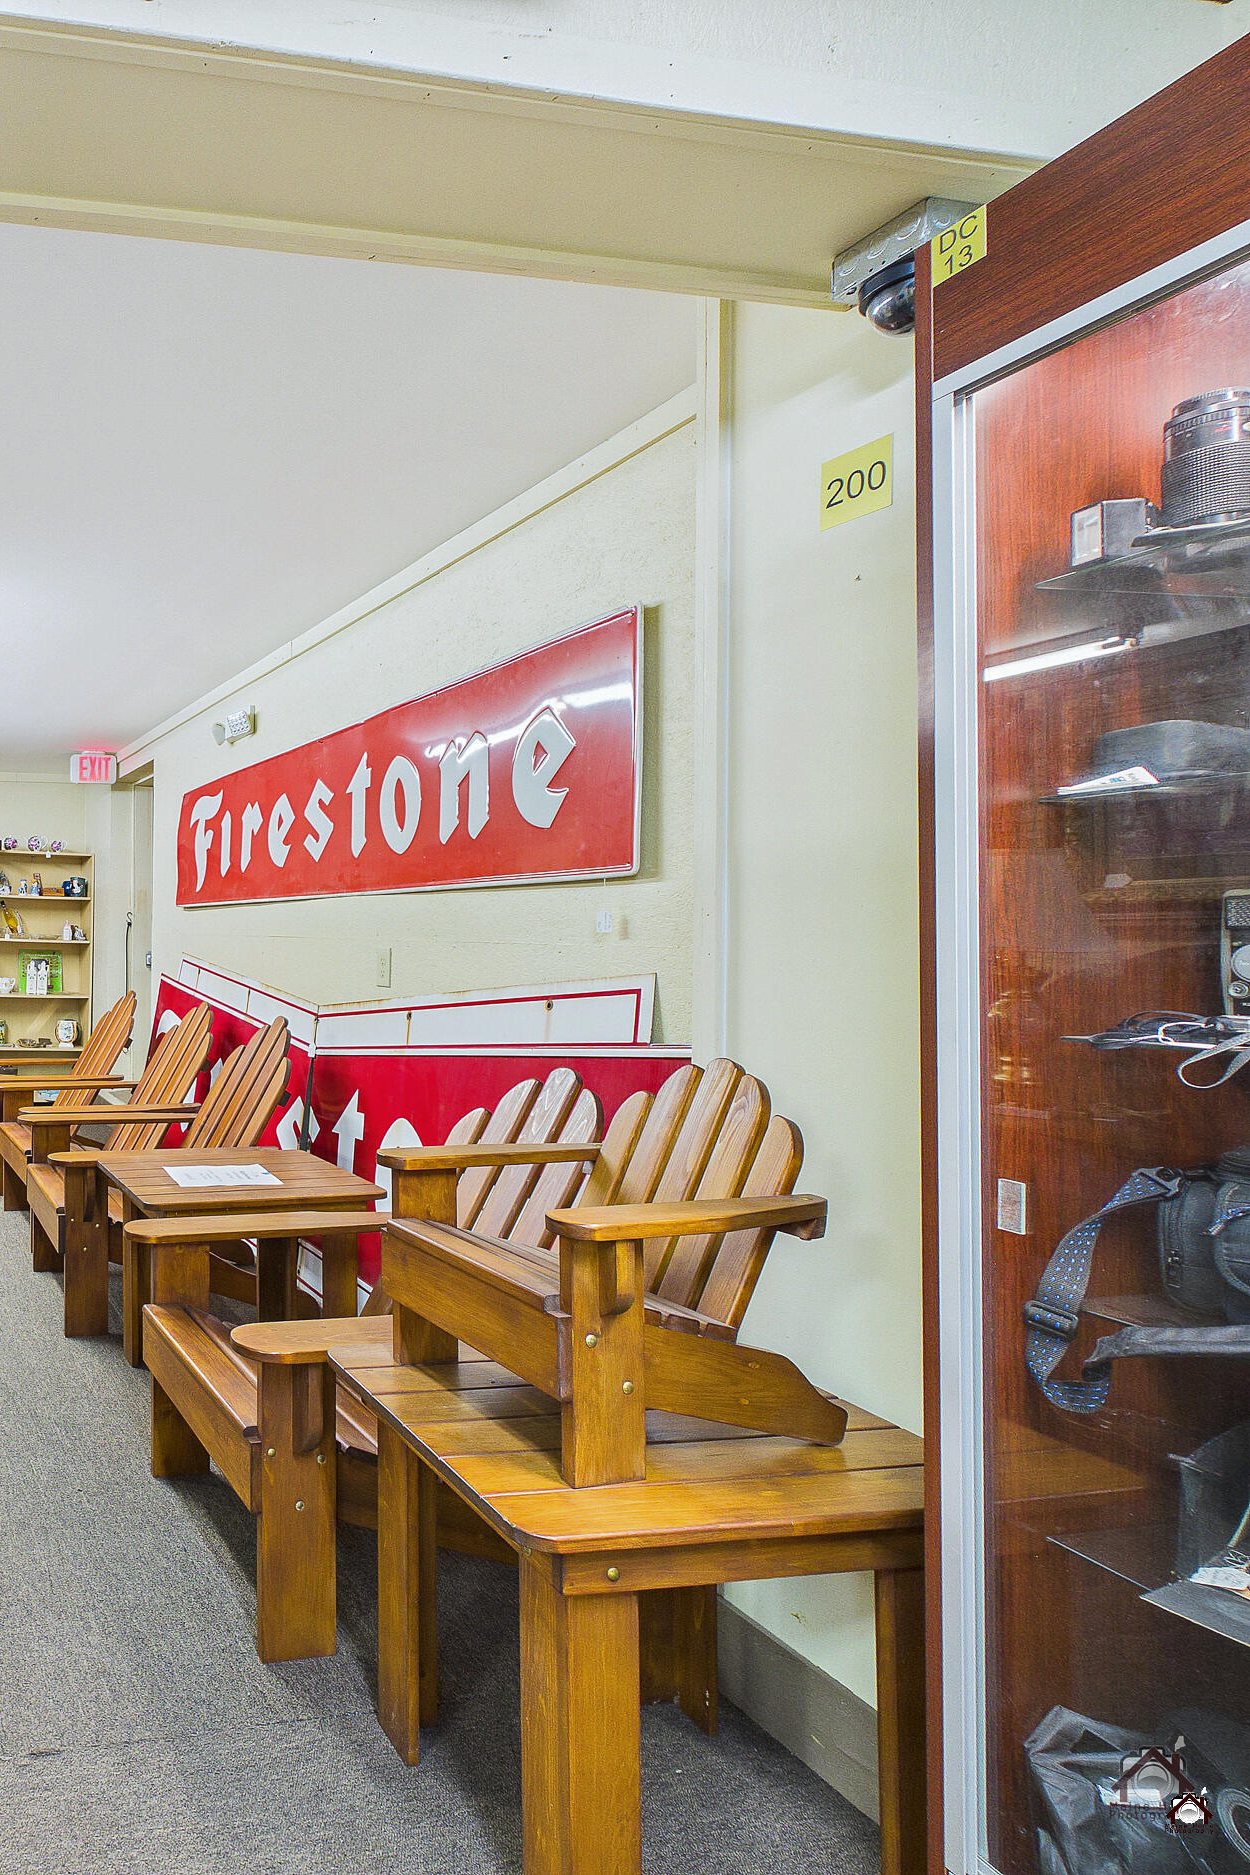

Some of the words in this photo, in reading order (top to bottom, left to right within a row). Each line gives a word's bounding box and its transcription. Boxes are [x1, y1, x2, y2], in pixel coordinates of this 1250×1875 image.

[940, 215, 977, 254] DC
[944, 245, 973, 274] 13
[826, 460, 886, 509] 200
[79, 756, 111, 782] EXIT
[190, 705, 576, 892] Firestone
